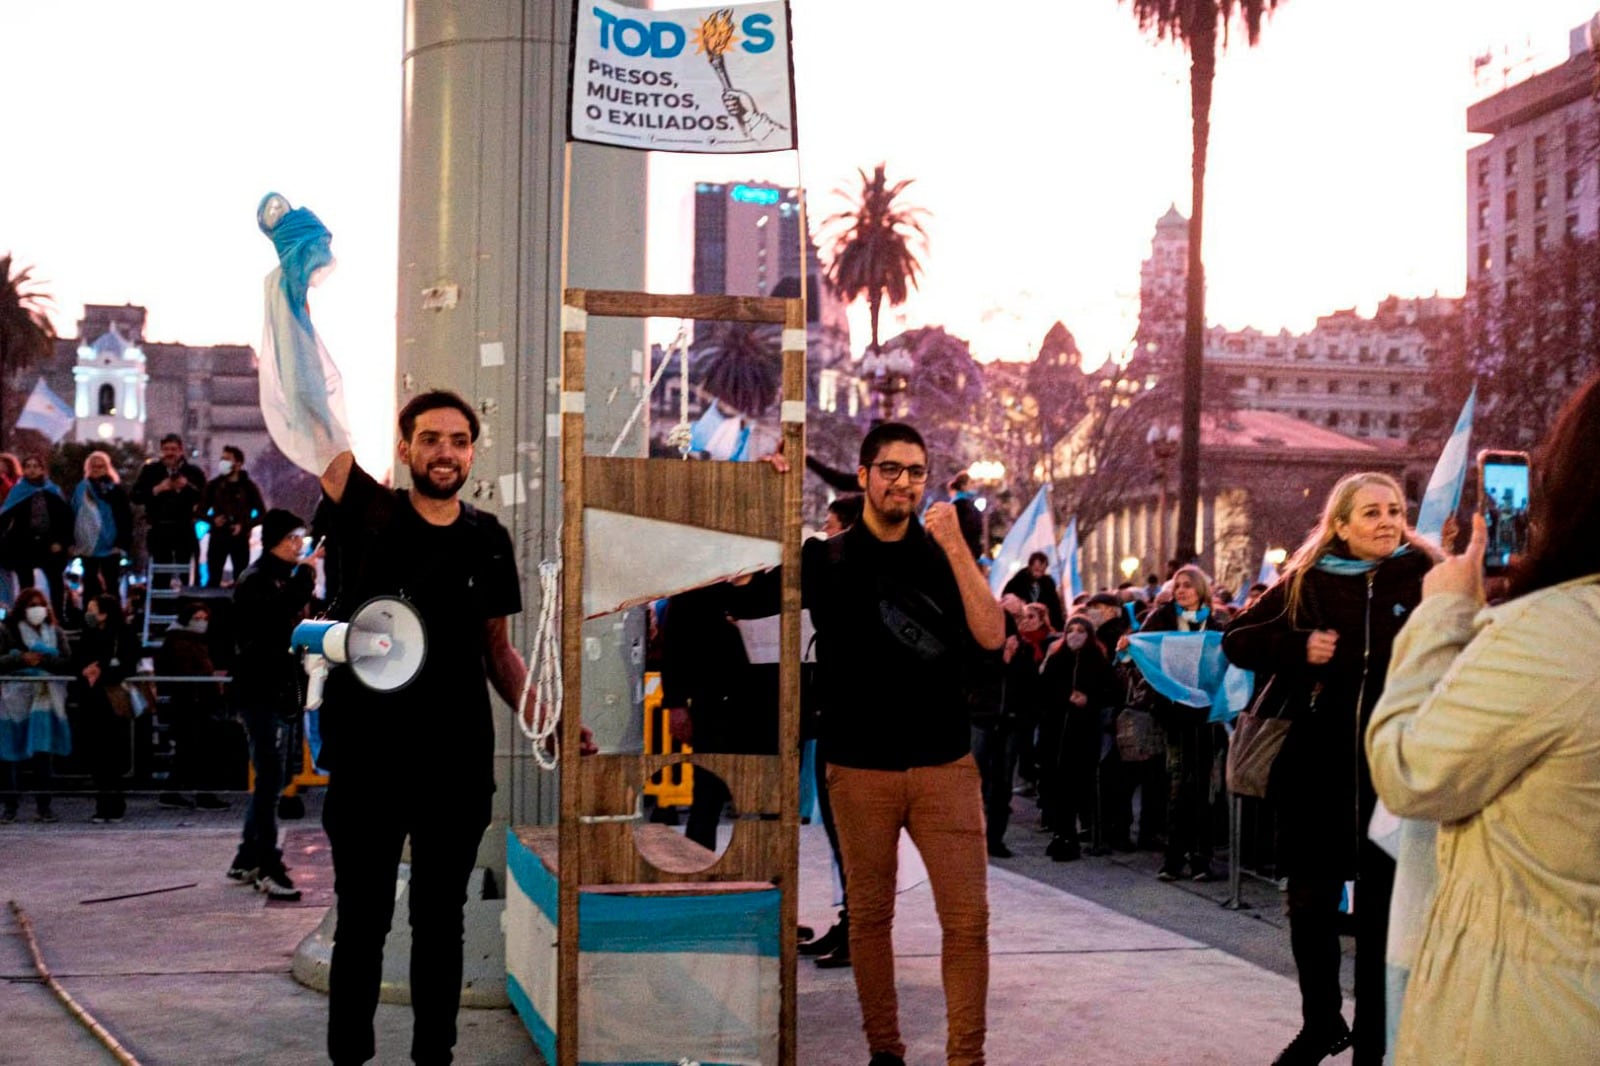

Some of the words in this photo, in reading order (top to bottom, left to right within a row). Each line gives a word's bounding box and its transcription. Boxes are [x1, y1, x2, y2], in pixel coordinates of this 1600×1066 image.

[588, 58, 679, 89] PRESOS,
[586, 81, 700, 111] MUERTOS,
[586, 104, 602, 120] O
[608, 109, 734, 131] EXILIADOS.
